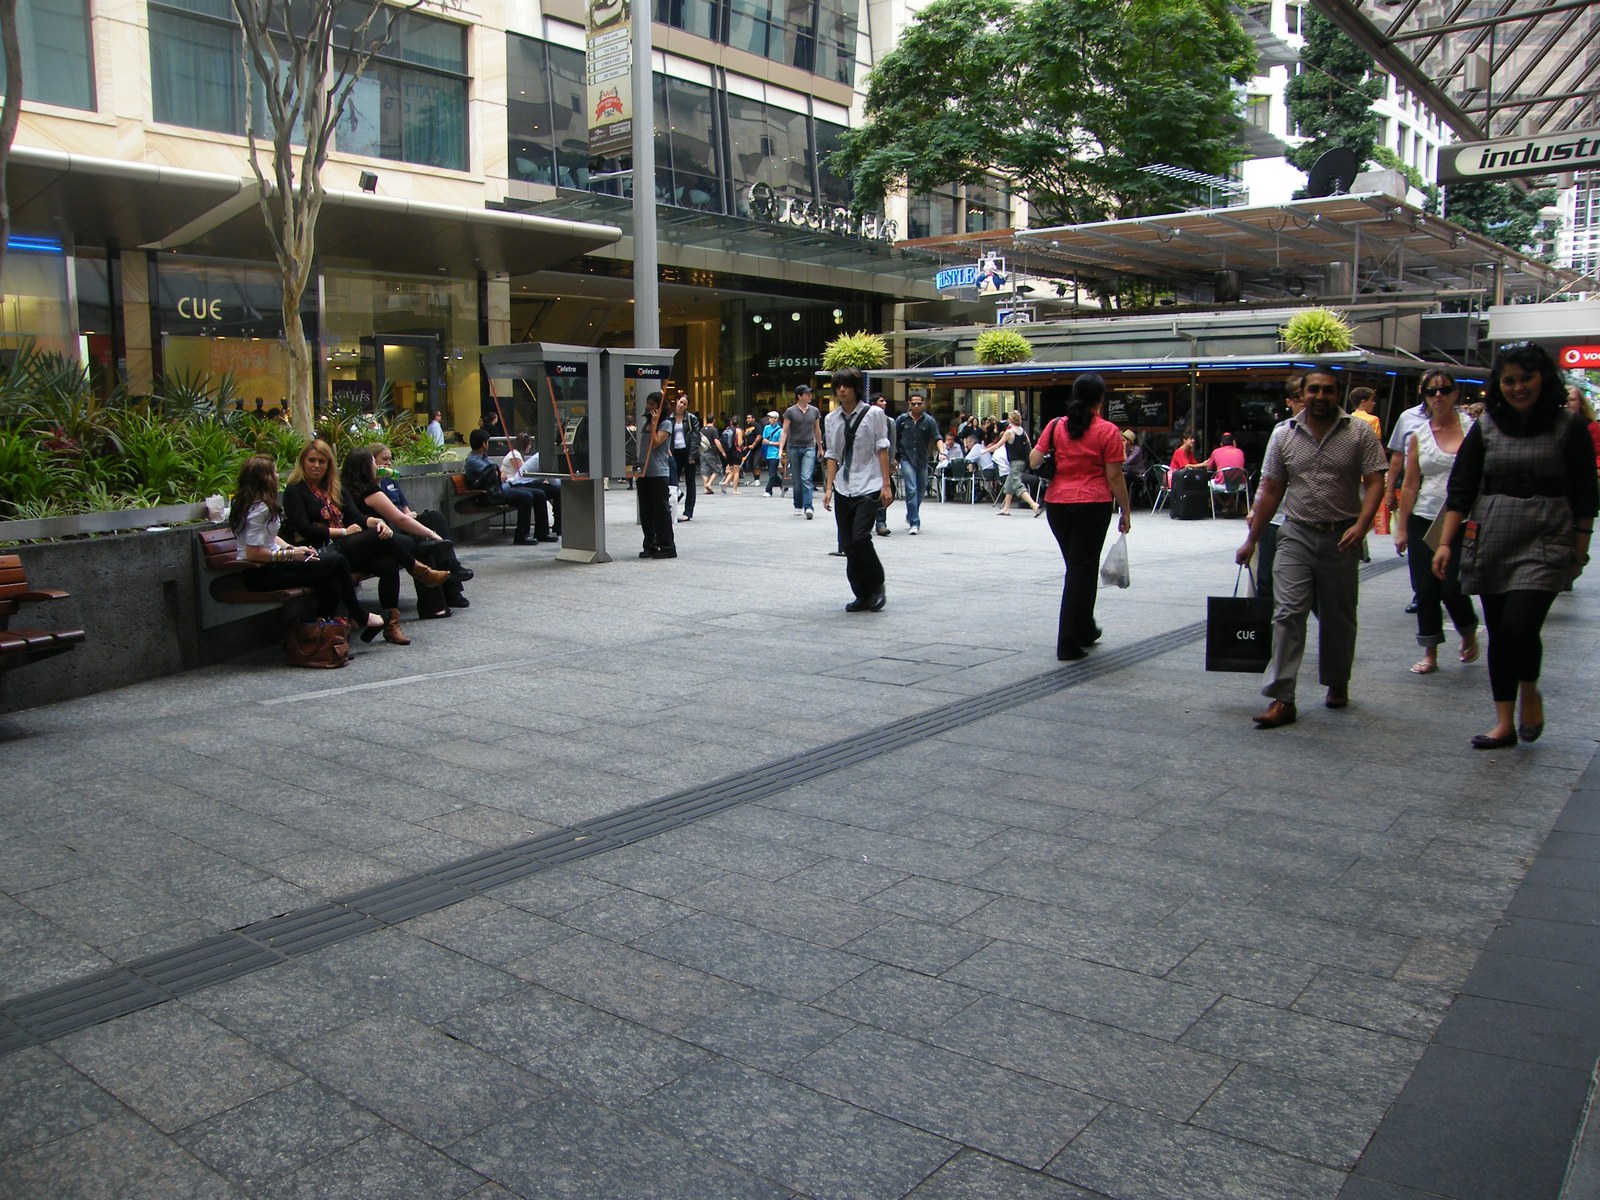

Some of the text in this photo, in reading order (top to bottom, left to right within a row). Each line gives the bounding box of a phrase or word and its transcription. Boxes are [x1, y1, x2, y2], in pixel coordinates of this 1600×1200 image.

[177, 297, 222, 320] CUE
[1583, 353, 1600, 361] vo
[780, 358, 819, 367] FOSSIL
[557, 365, 577, 374] Telstra
[637, 367, 660, 376] Telstra
[1236, 630, 1255, 640] CUE
